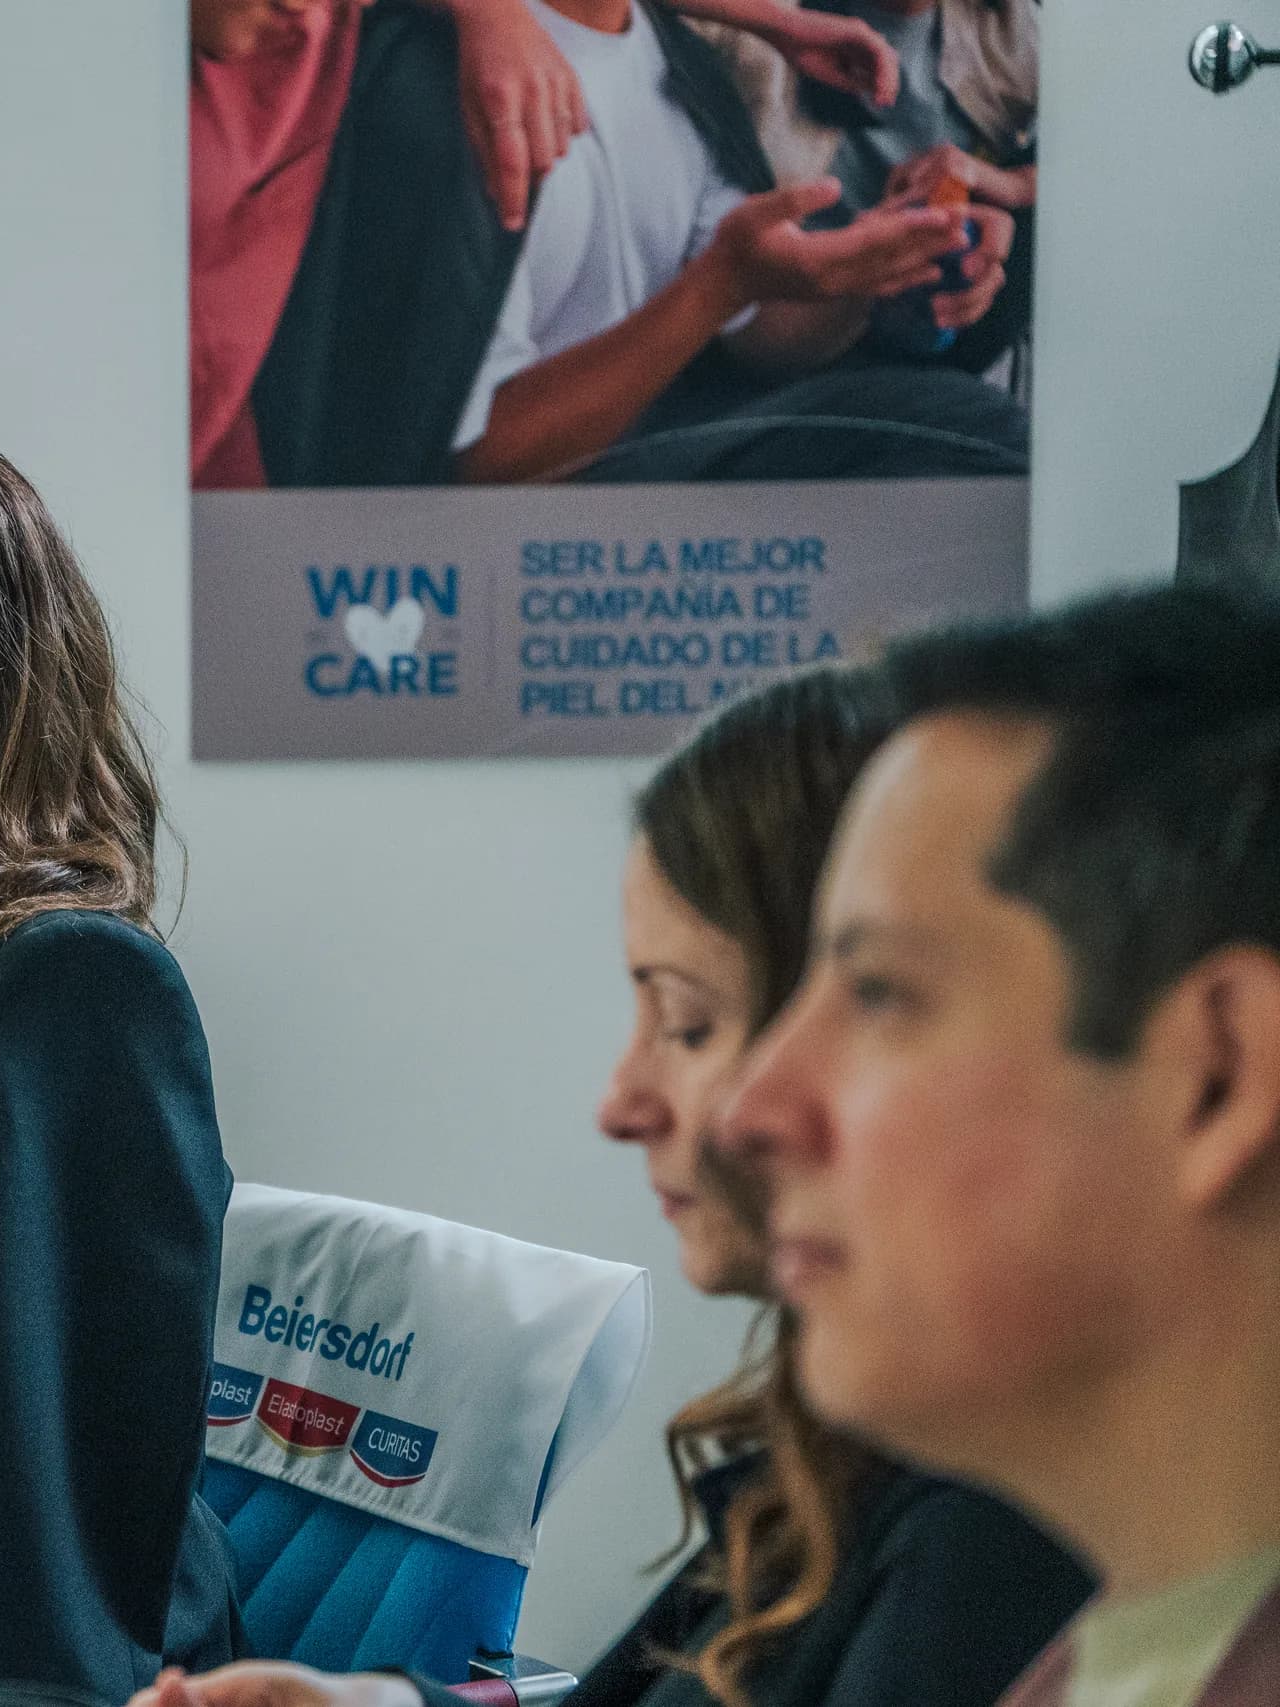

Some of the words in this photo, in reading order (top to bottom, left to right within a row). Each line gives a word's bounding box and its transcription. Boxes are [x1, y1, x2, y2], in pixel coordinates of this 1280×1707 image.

[522, 540, 603, 575] SER
[616, 540, 669, 575] LA
[680, 538, 825, 574] MEJOR
[306, 564, 459, 618] WIN
[753, 583, 809, 620] DE
[521, 633, 710, 669] CUIDADO
[723, 631, 774, 666] DE
[786, 630, 839, 664] LA
[305, 653, 457, 696] CARE
[521, 679, 609, 716] PIEL
[620, 678, 708, 715] DEL
[238, 1284, 415, 1381] Beiersdorf
[267, 1393, 345, 1436] Elastoplast
[368, 1427, 422, 1463] CURITAS
